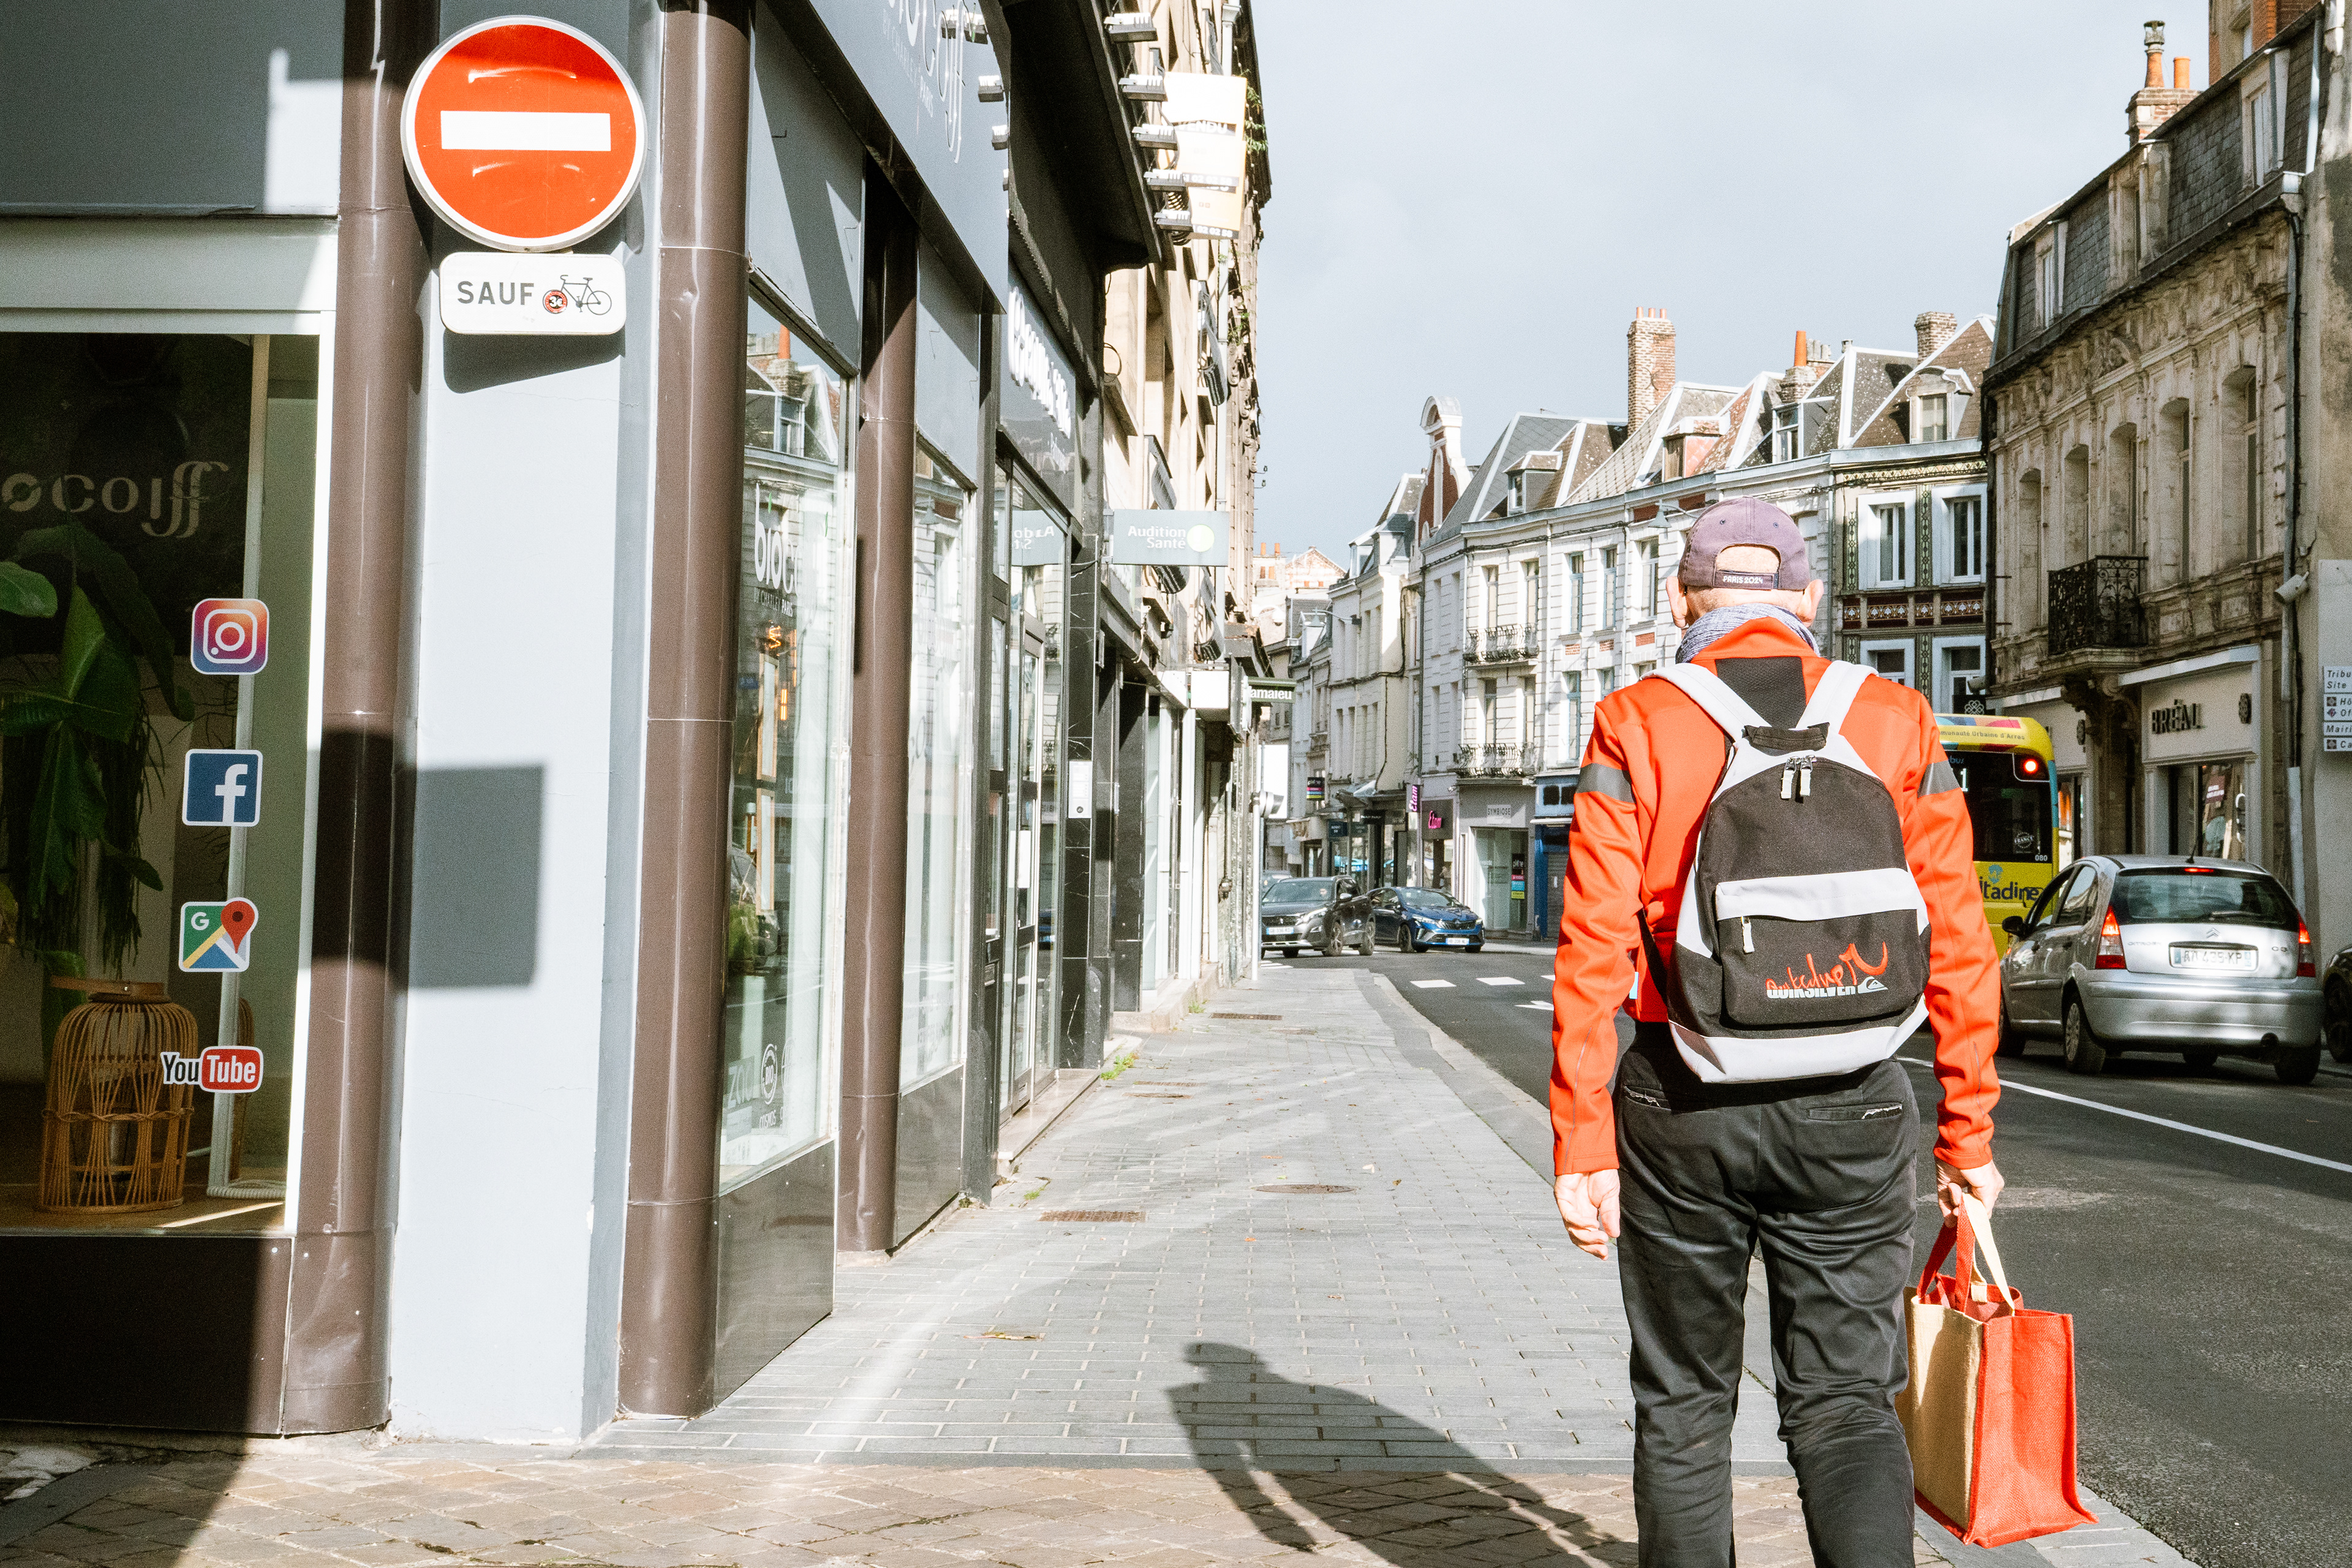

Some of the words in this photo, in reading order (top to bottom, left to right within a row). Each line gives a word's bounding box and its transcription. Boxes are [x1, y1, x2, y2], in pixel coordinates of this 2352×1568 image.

[920, 75, 933, 118] PARIS
[458, 281, 535, 305] SAUF
[1128, 526, 1186, 538] Audition
[1147, 537, 1186, 549] Santé
[782, 598, 793, 617] PARIS
[2152, 699, 2206, 734] BRÉAL
[1409, 785, 1418, 812] Etam
[1428, 810, 1442, 829] Etam
[1979, 876, 2040, 901] itadine
[765, 1065, 774, 1085] BIO
[759, 1109, 777, 1129] COSMOS
